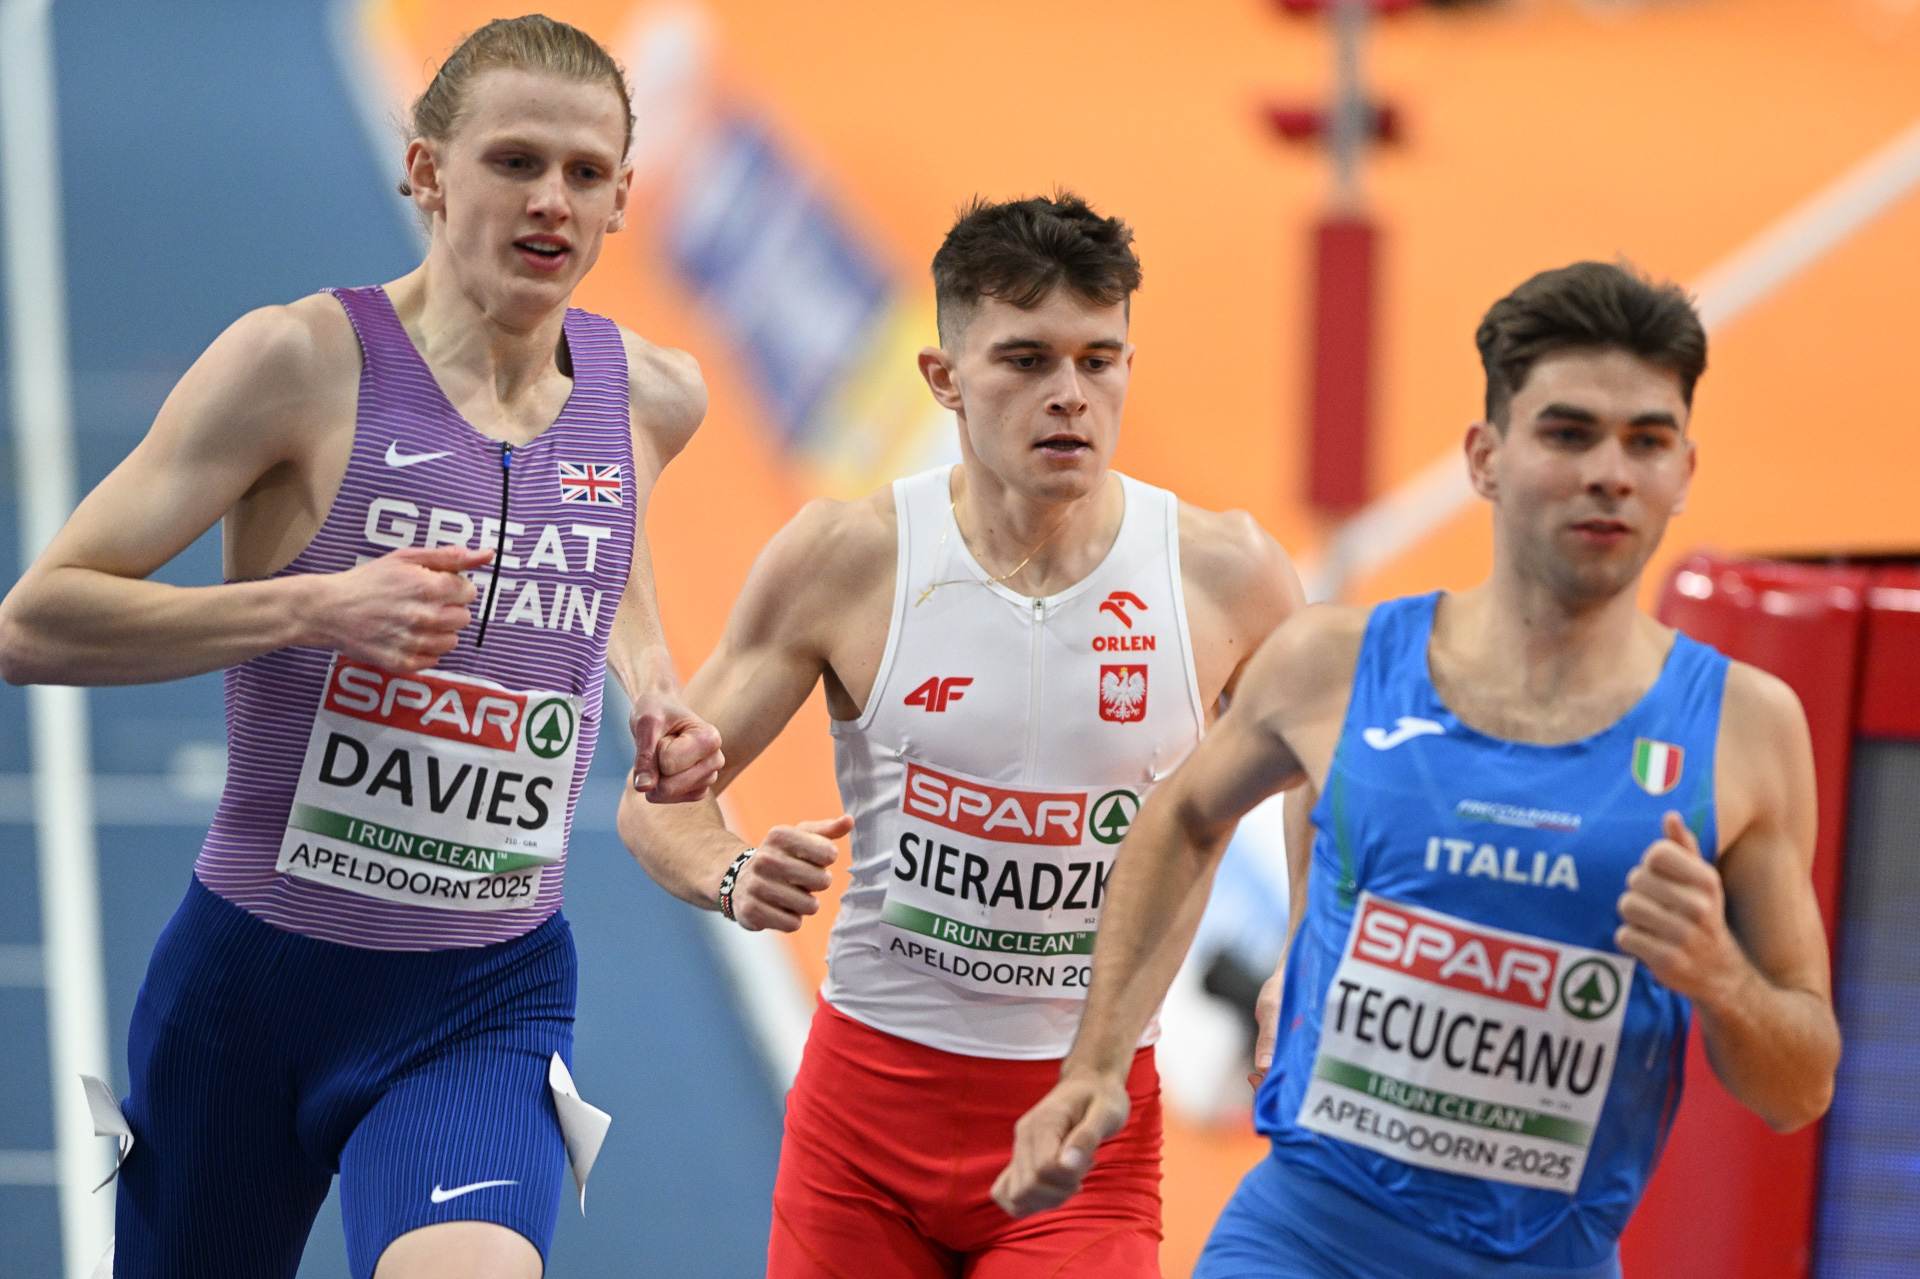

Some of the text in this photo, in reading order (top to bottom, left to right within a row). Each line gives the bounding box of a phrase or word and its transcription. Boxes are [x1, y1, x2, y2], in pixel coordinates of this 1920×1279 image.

[364, 497, 611, 572] GREAT
[356, 554, 602, 636] TAIN
[1092, 635, 1156, 652] ORLEN
[333, 665, 519, 742] SPAR
[904, 676, 974, 712] 4F
[318, 732, 554, 830] DAVIES
[909, 773, 1081, 838] SPAR
[346, 820, 356, 840] I
[359, 824, 415, 855] RUN
[1424, 836, 1580, 891] ITALIA
[289, 843, 533, 900] APELDOORN 2025
[894, 832, 1116, 911] SIERADZK
[890, 937, 1092, 988] APELDOORN 20
[932, 918, 940, 935] I
[943, 920, 993, 948] RUN
[1359, 909, 1554, 999] SPAR
[1332, 980, 1605, 1097] TECUCEANU
[1367, 1075, 1377, 1095] I
[1379, 1077, 1437, 1112] RUN
[1313, 1095, 1575, 1180] APELDOORN 2025
